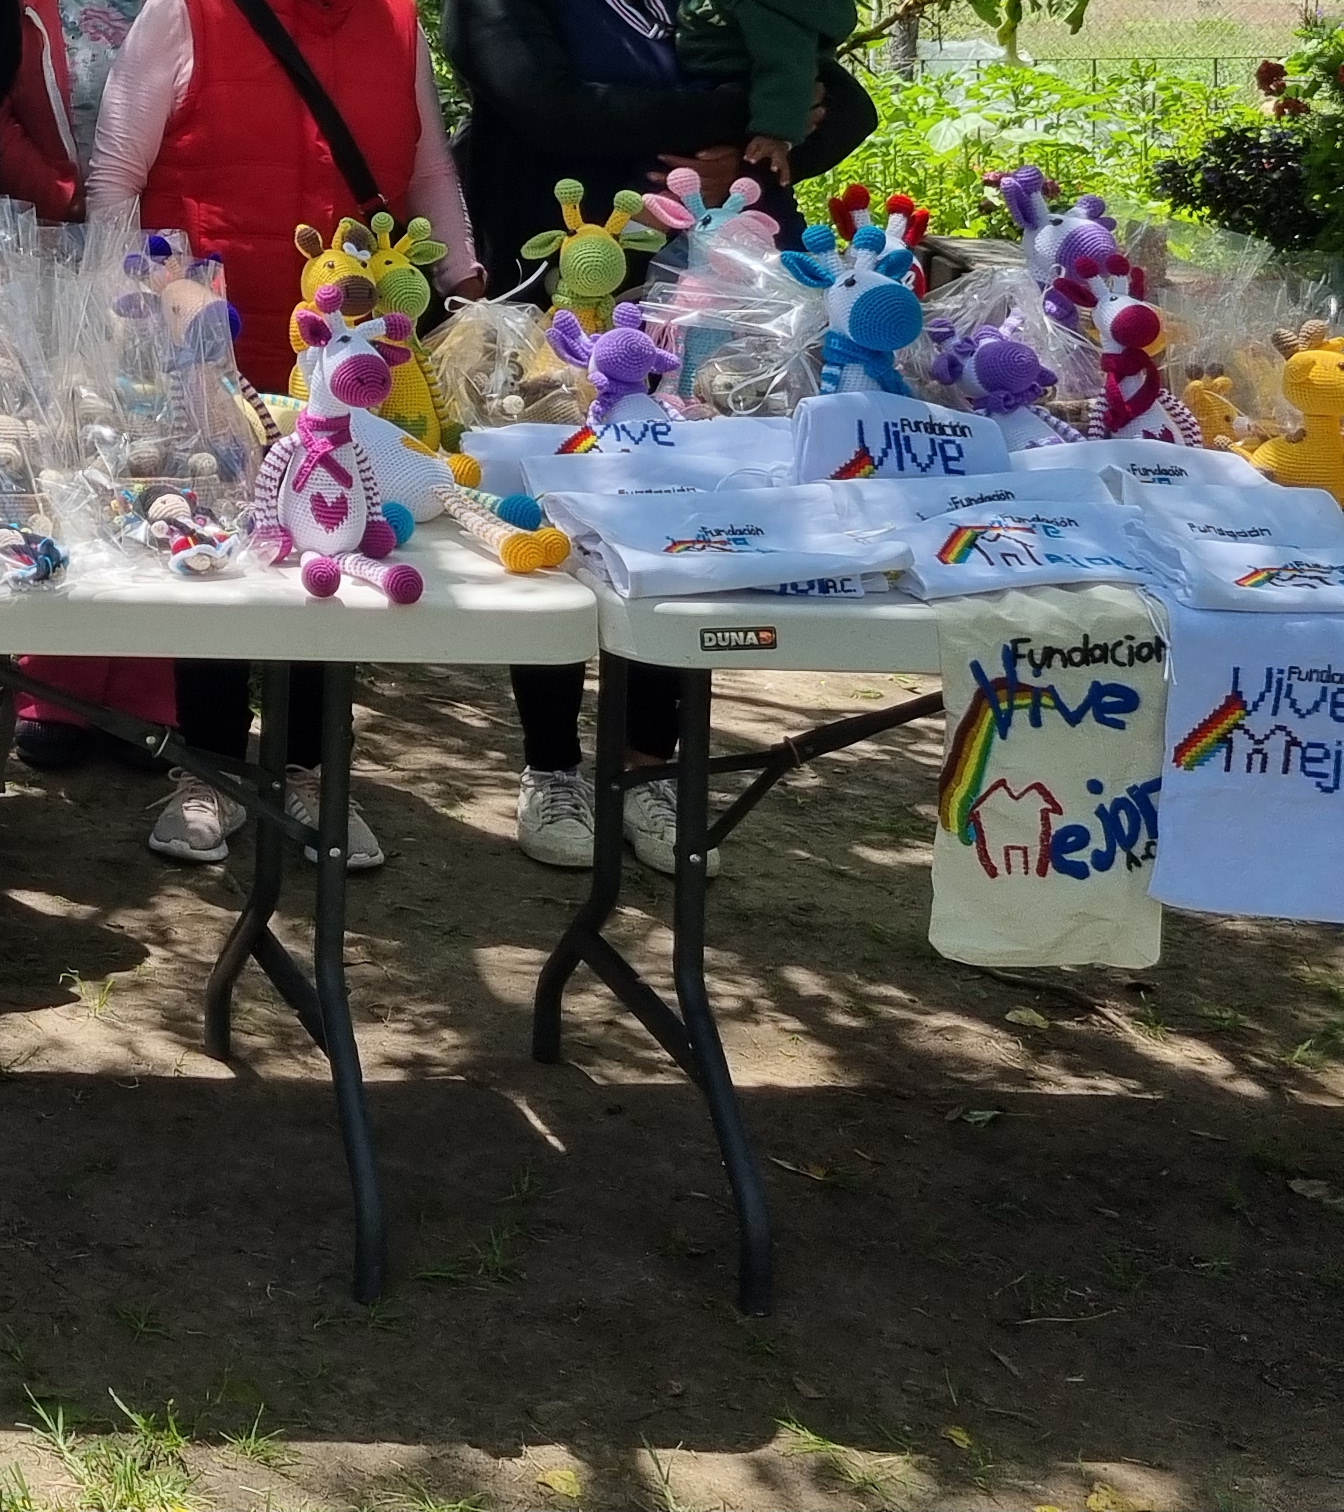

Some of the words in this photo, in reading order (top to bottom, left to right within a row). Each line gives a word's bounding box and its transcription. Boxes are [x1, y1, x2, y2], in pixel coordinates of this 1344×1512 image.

[900, 415, 973, 438] Fundación
[703, 631, 759, 647] DUNA
[969, 643, 1140, 739] Vive
